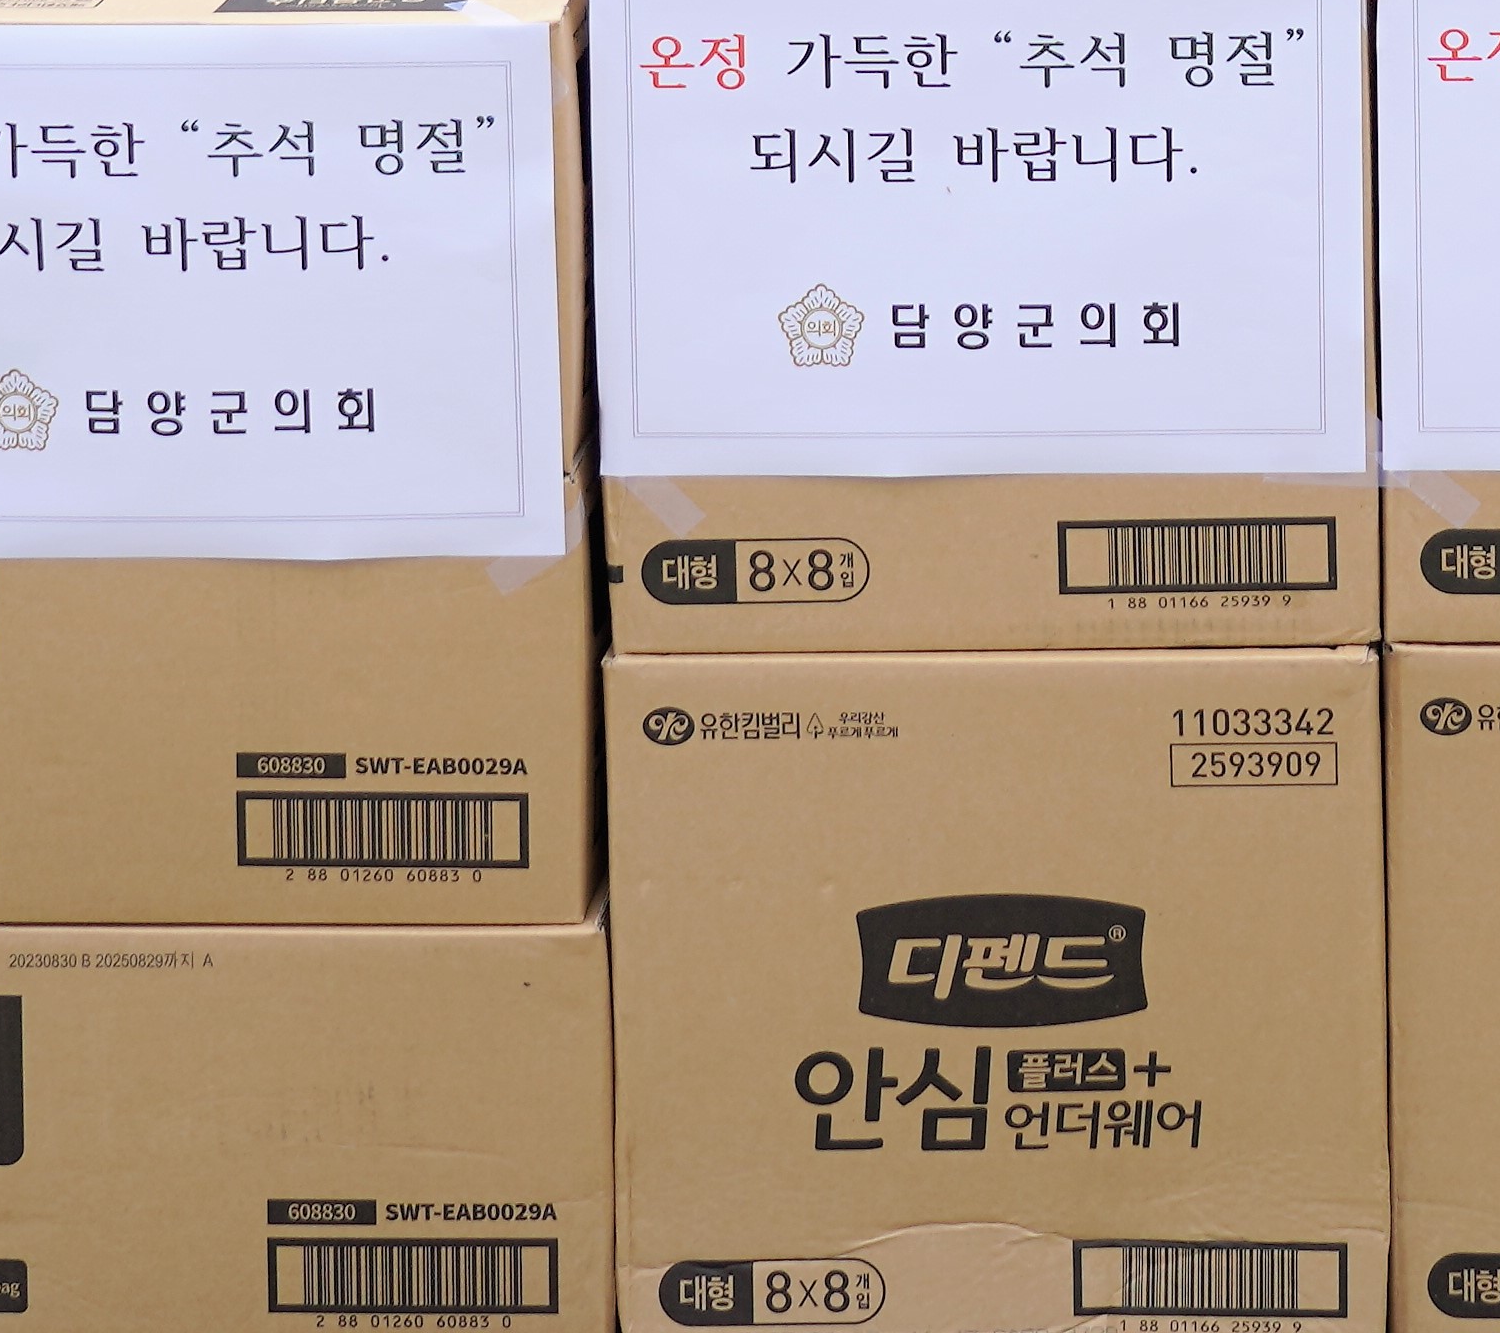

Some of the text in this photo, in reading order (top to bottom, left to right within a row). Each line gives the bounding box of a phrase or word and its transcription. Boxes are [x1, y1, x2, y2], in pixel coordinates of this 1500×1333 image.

[640, 34, 745, 89] 온정
[788, 34, 957, 89] 가득한
[751, 127, 1197, 183] 되시길 바랍니다.
[142, 215, 388, 271] 바랍니다.
[661, 555, 719, 592] 대형
[1439, 545, 1498, 579] 대형
[701, 713, 800, 739] 유한킴벌리
[839, 712, 885, 725] 우리강산
[1173, 708, 1333, 736] 11033342
[256, 756, 527, 775] 608830 SWT-EAB0029A
[1192, 752, 1320, 777] 2593909
[10, 954, 77, 968] 20230830
[203, 954, 213, 967] A
[795, 1046, 991, 1151] 안심
[1005, 1100, 1201, 1150] 언더웨어
[288, 1202, 556, 1222] 608830 SWT-EAB0029A
